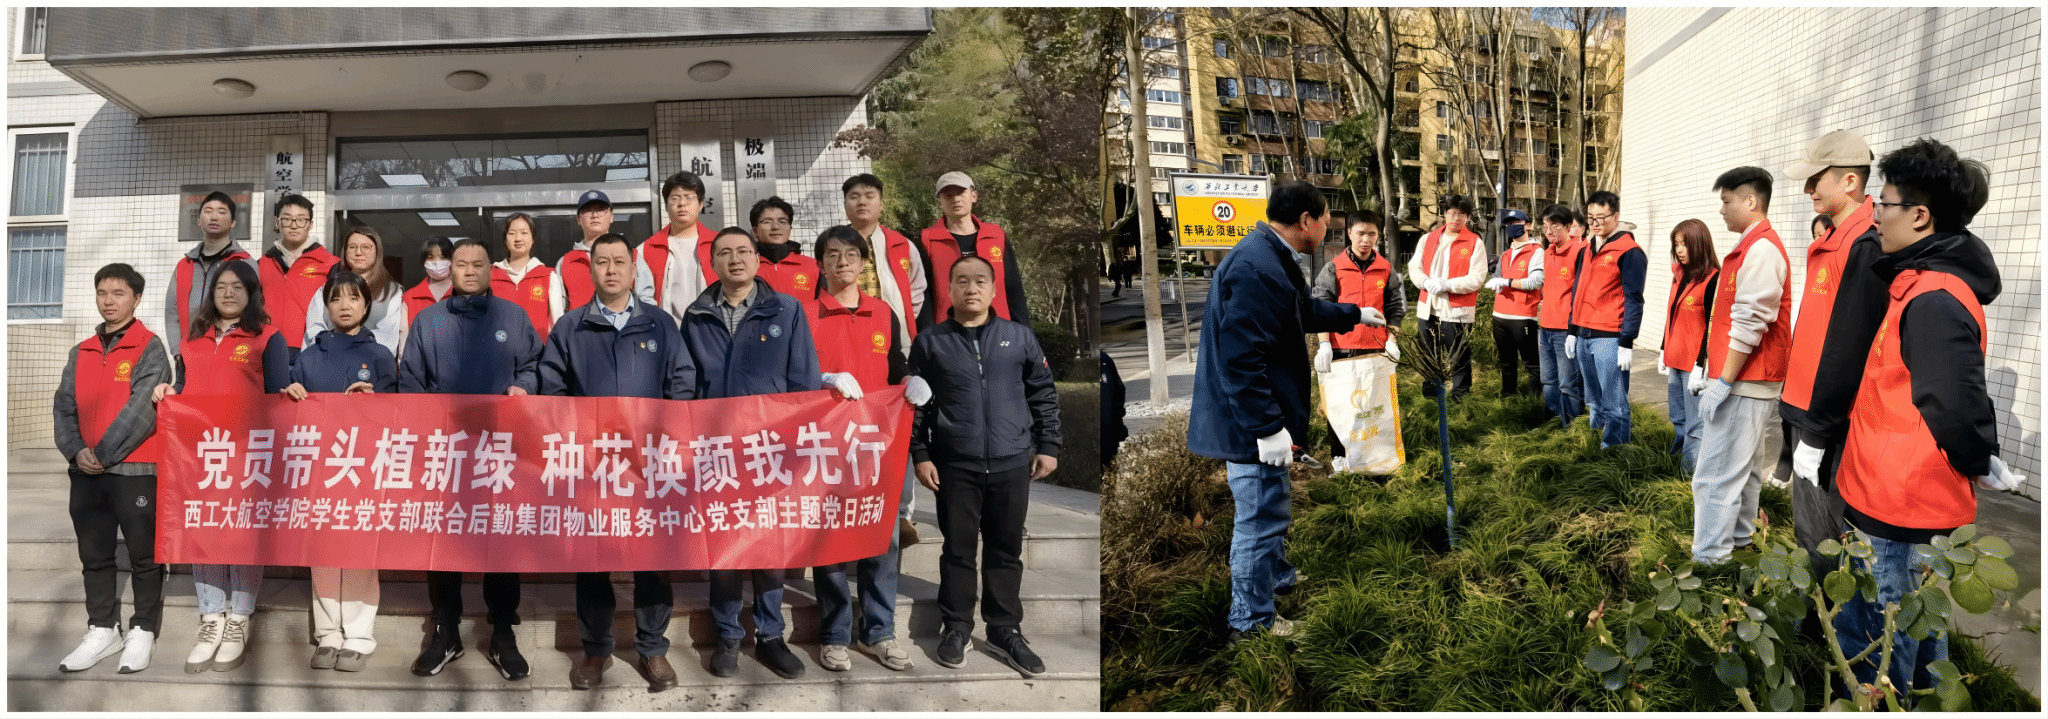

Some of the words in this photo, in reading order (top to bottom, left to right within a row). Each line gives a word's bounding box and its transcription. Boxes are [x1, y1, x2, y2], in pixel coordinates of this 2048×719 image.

[745, 138, 766, 180] 极端
[1217, 206, 1230, 218] 20
[197, 425, 517, 494] 党员带头植新绿
[540, 420, 886, 499] 种花换颜我先行
[184, 492, 885, 537] 西工大航空学院学生党支部联合后勤集团物业服务中心党支部主题党日活动
